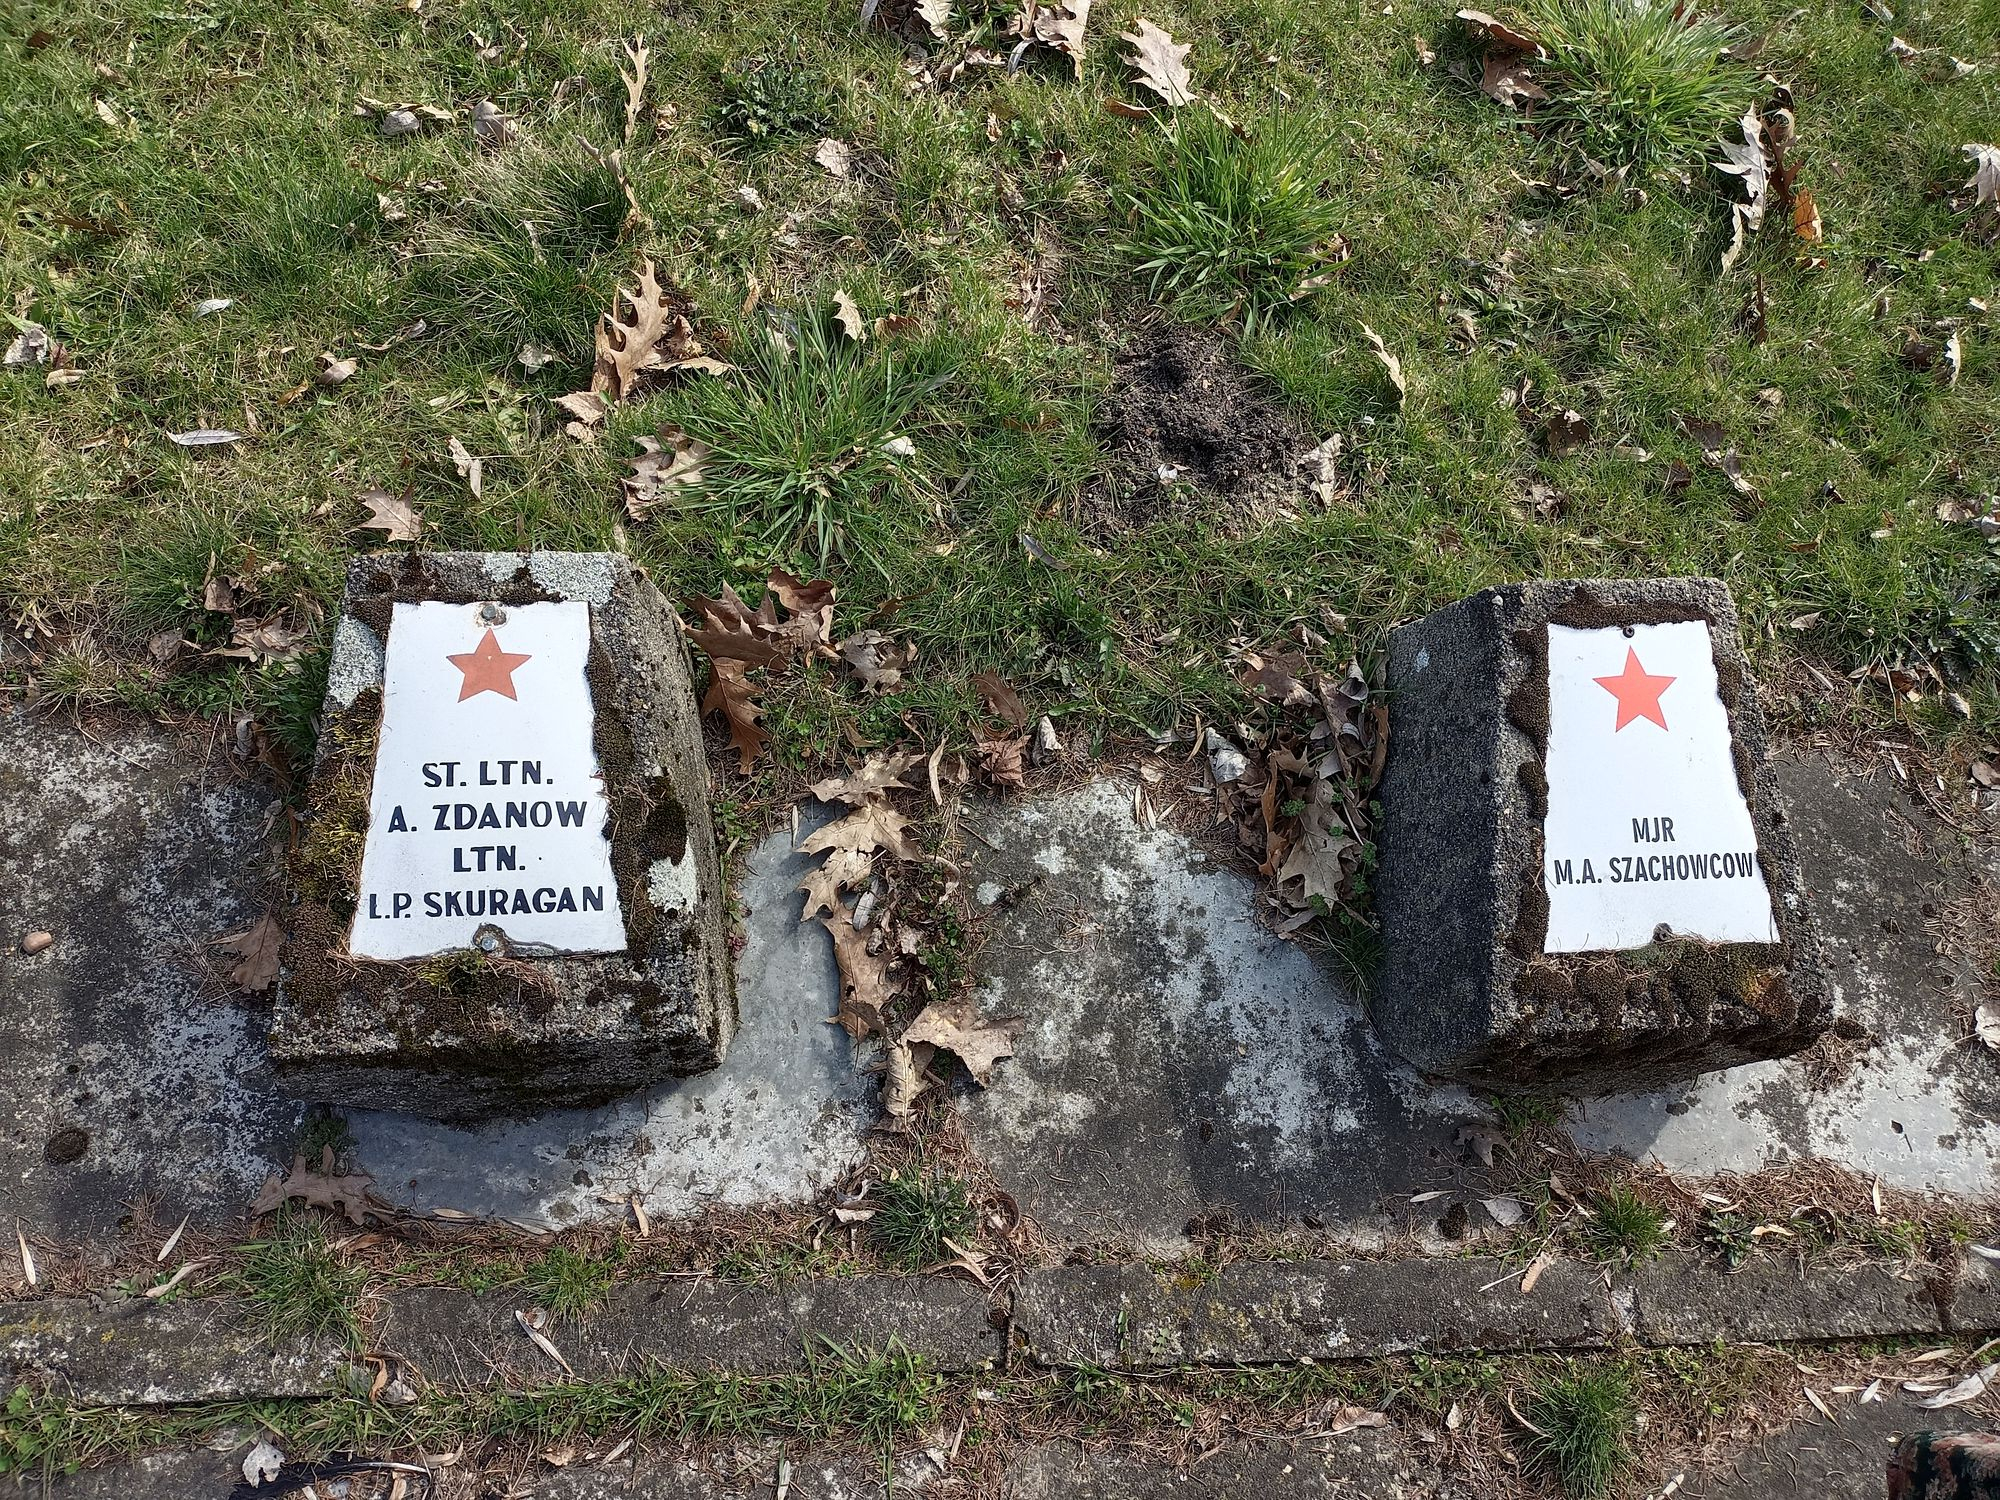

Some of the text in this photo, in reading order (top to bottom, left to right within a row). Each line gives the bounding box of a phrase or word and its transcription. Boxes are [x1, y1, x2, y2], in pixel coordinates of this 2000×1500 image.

[422, 760, 553, 788] ST. LTN.
[387, 801, 588, 832] A. ZDANOW
[1632, 817, 1676, 843] MJR
[453, 845, 526, 872] LTN.
[1554, 853, 1753, 884] M.A. SZACHOWCOW
[423, 886, 604, 917] SKURAGAN
